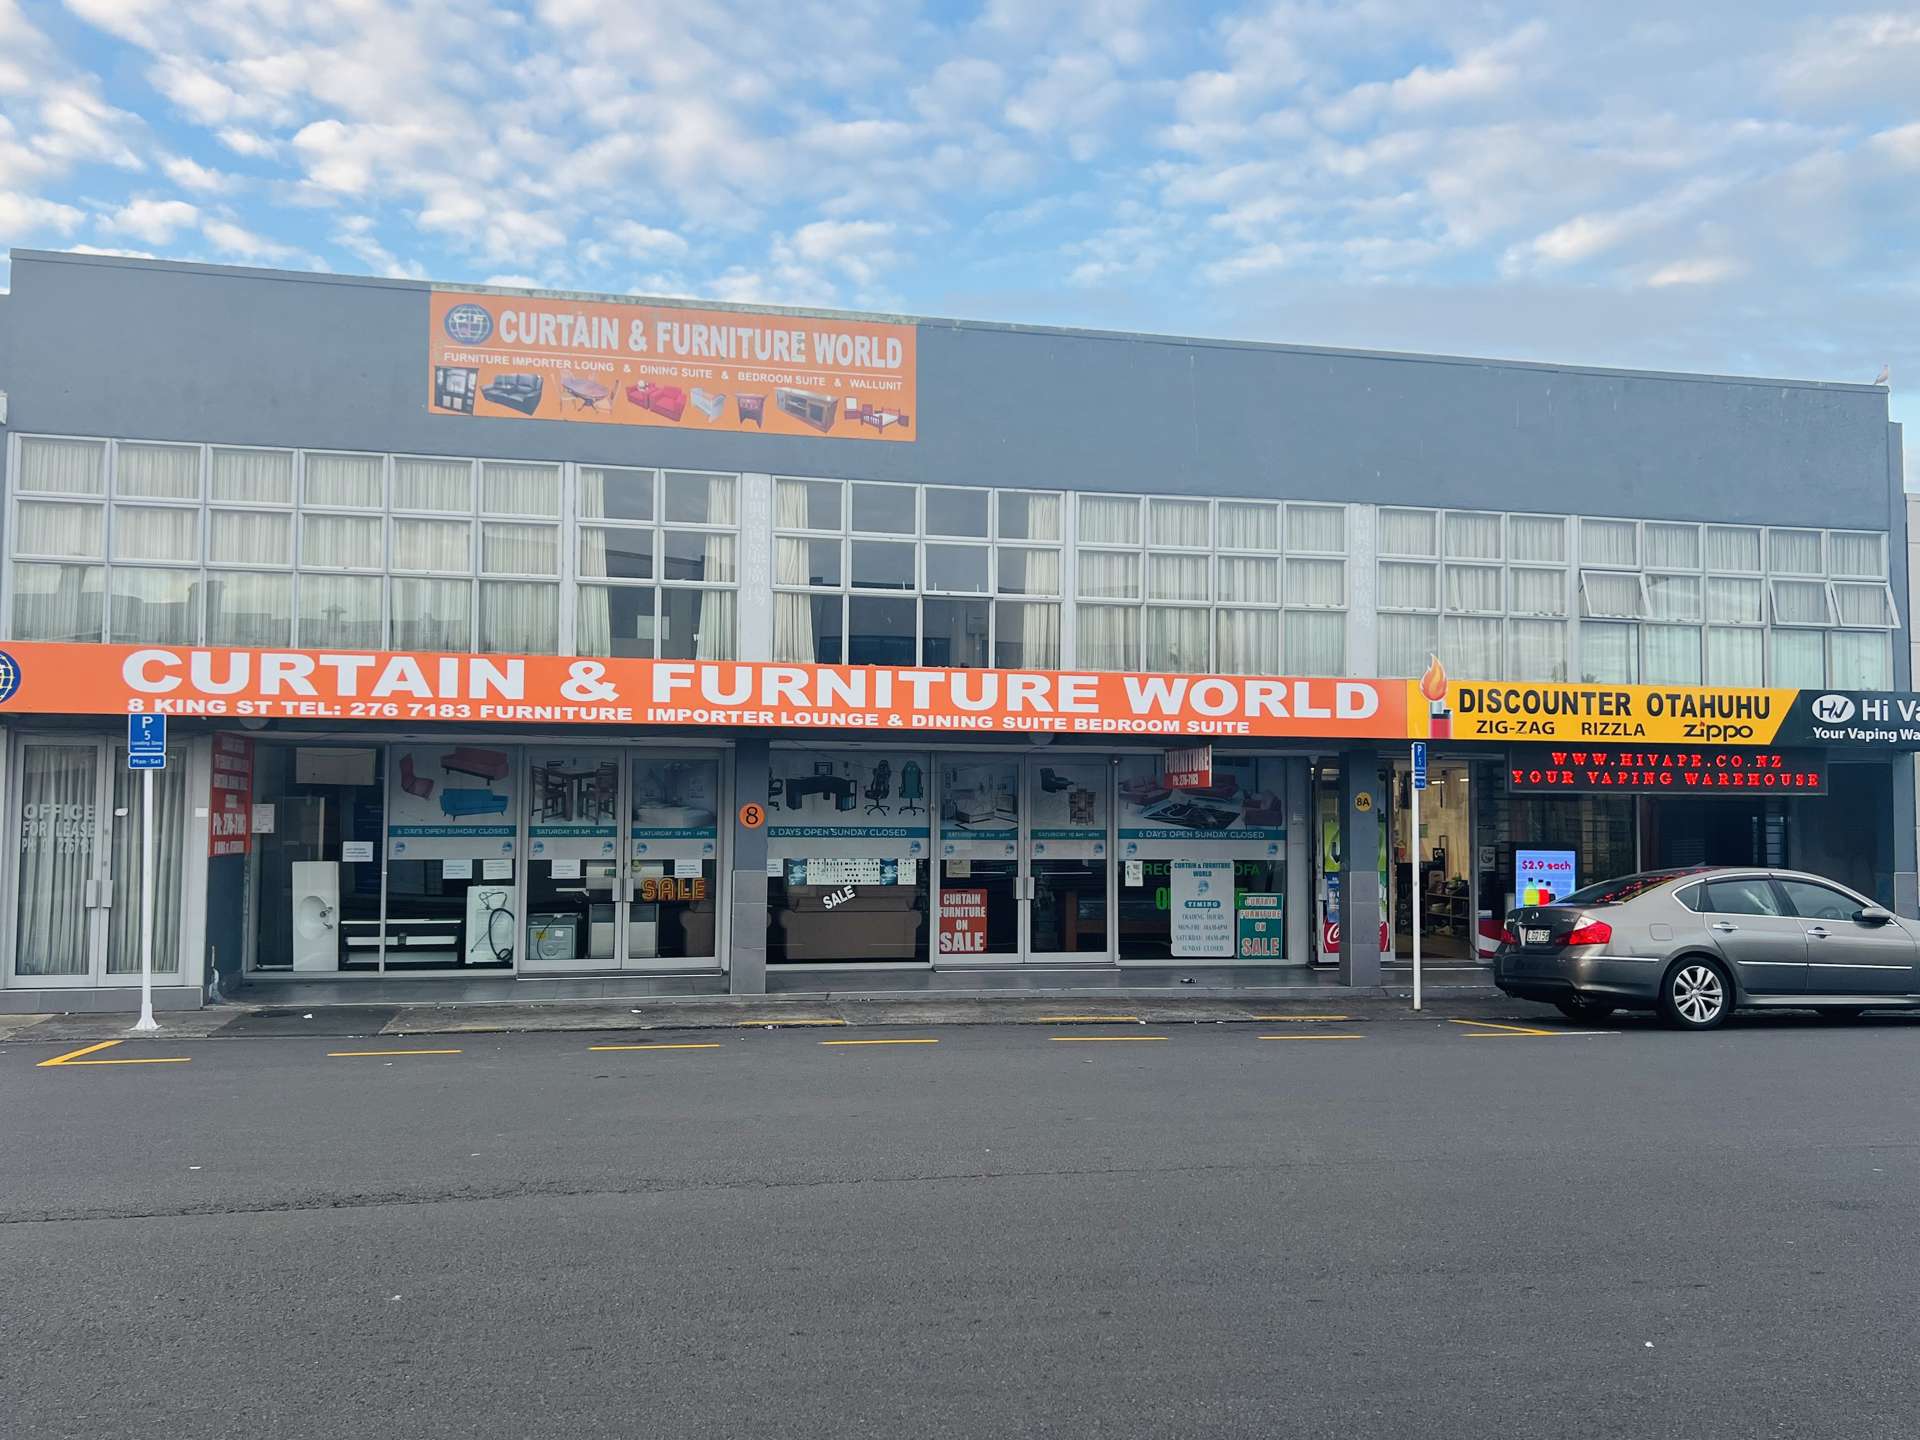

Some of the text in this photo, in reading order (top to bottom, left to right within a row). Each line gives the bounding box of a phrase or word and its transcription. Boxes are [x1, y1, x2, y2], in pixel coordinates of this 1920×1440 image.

[500, 310, 903, 369] CURTAIN & FURNITURE WORLD
[444, 352, 902, 391] FURNITURE IMPORTER LOUNG & DINING SUITE & BEDROOM SUITE & WALLUNIT
[122, 650, 1379, 719] CURTAIN & FURNITURE WORLD
[1459, 688, 1770, 720] DISCOUNTER OTAHUHU
[1862, 699, 1889, 721] Hi
[128, 698, 1250, 734] 8 KING ST TEL: 276 7183 FURNITURE IMPORTER LOUNGE & DINING SUITE BEDROOM SUITE
[142, 716, 153, 728] P
[144, 730, 151, 740] 5
[1476, 720, 1555, 735] ZIG-ZAG
[1581, 722, 1646, 736] RIZZLA
[1813, 727, 1845, 740] Your
[1848, 728, 1898, 742] Vaping
[1417, 745, 1423, 756] P
[1165, 746, 1209, 774] FURNITURE
[1551, 752, 1783, 769] WWW.HIVAPE.CO.NZ
[1512, 770, 1819, 788] YOUR VAPING WAREHOUSE
[1356, 797, 1370, 807] 8A
[24, 804, 95, 820] OFFICE
[745, 806, 759, 825] 8
[23, 821, 95, 837] FOR LEASE
[778, 828, 801, 836] DAYS
[803, 828, 831, 836] OPEN
[831, 828, 867, 836] SUNDAY
[869, 828, 907, 837] CLOSED
[1195, 831, 1228, 839] SUNDAY
[1230, 831, 1265, 839] CLOSED
[1521, 860, 1571, 870] $2.9 each
[641, 877, 705, 901] SALE
[822, 885, 856, 910] SALE
[943, 893, 981, 905] CURTAIN
[940, 906, 986, 918] FURNITURE
[955, 919, 968, 931] ON
[940, 932, 985, 952] SALE
[1241, 937, 1280, 956] SALE
